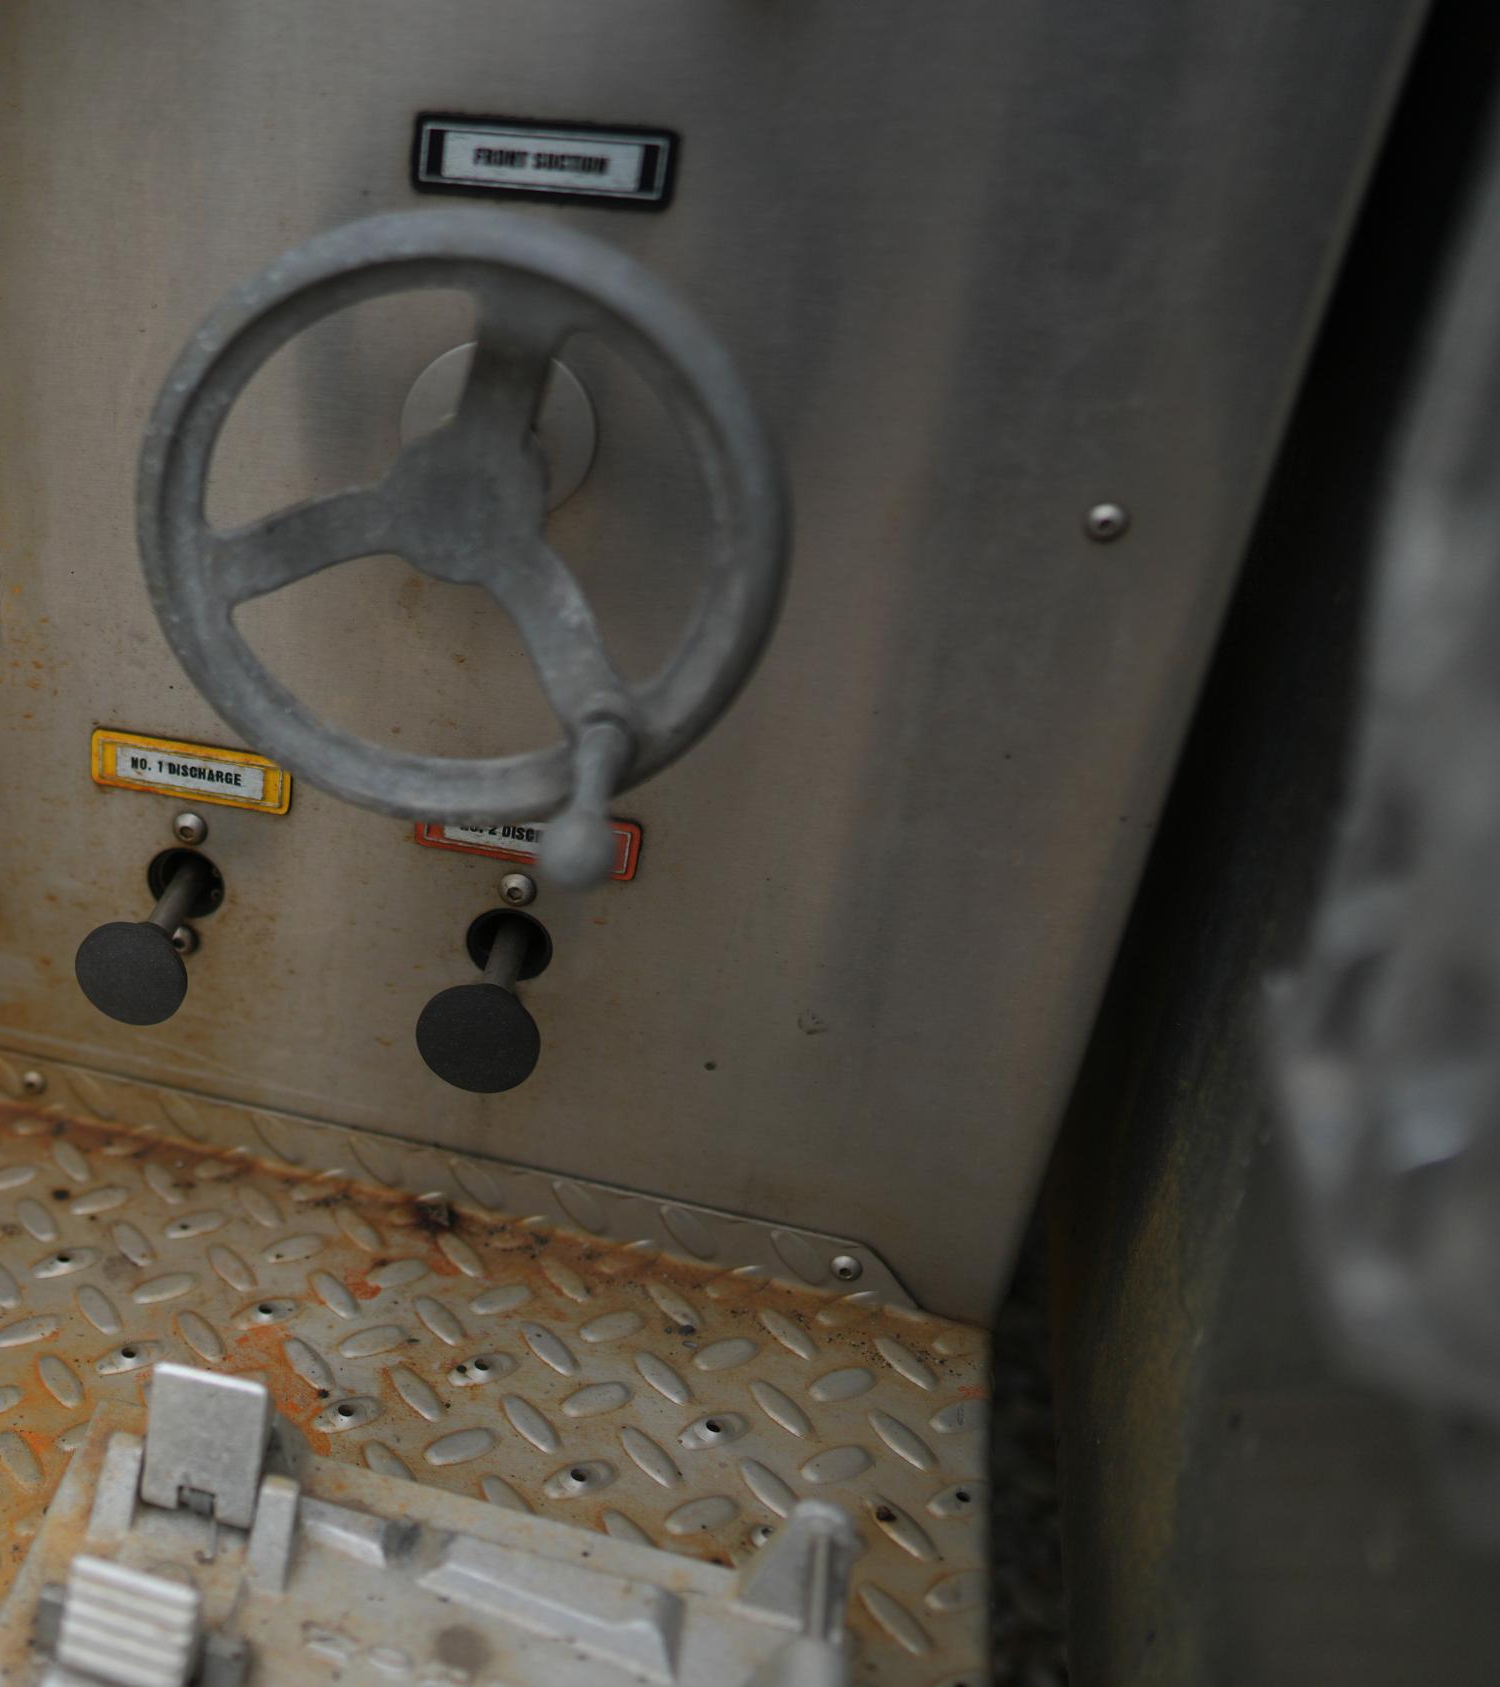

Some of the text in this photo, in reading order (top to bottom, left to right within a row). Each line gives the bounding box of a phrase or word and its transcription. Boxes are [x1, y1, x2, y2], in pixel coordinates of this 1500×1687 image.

[130, 756, 242, 788] NO. 1 DISCHARGE
